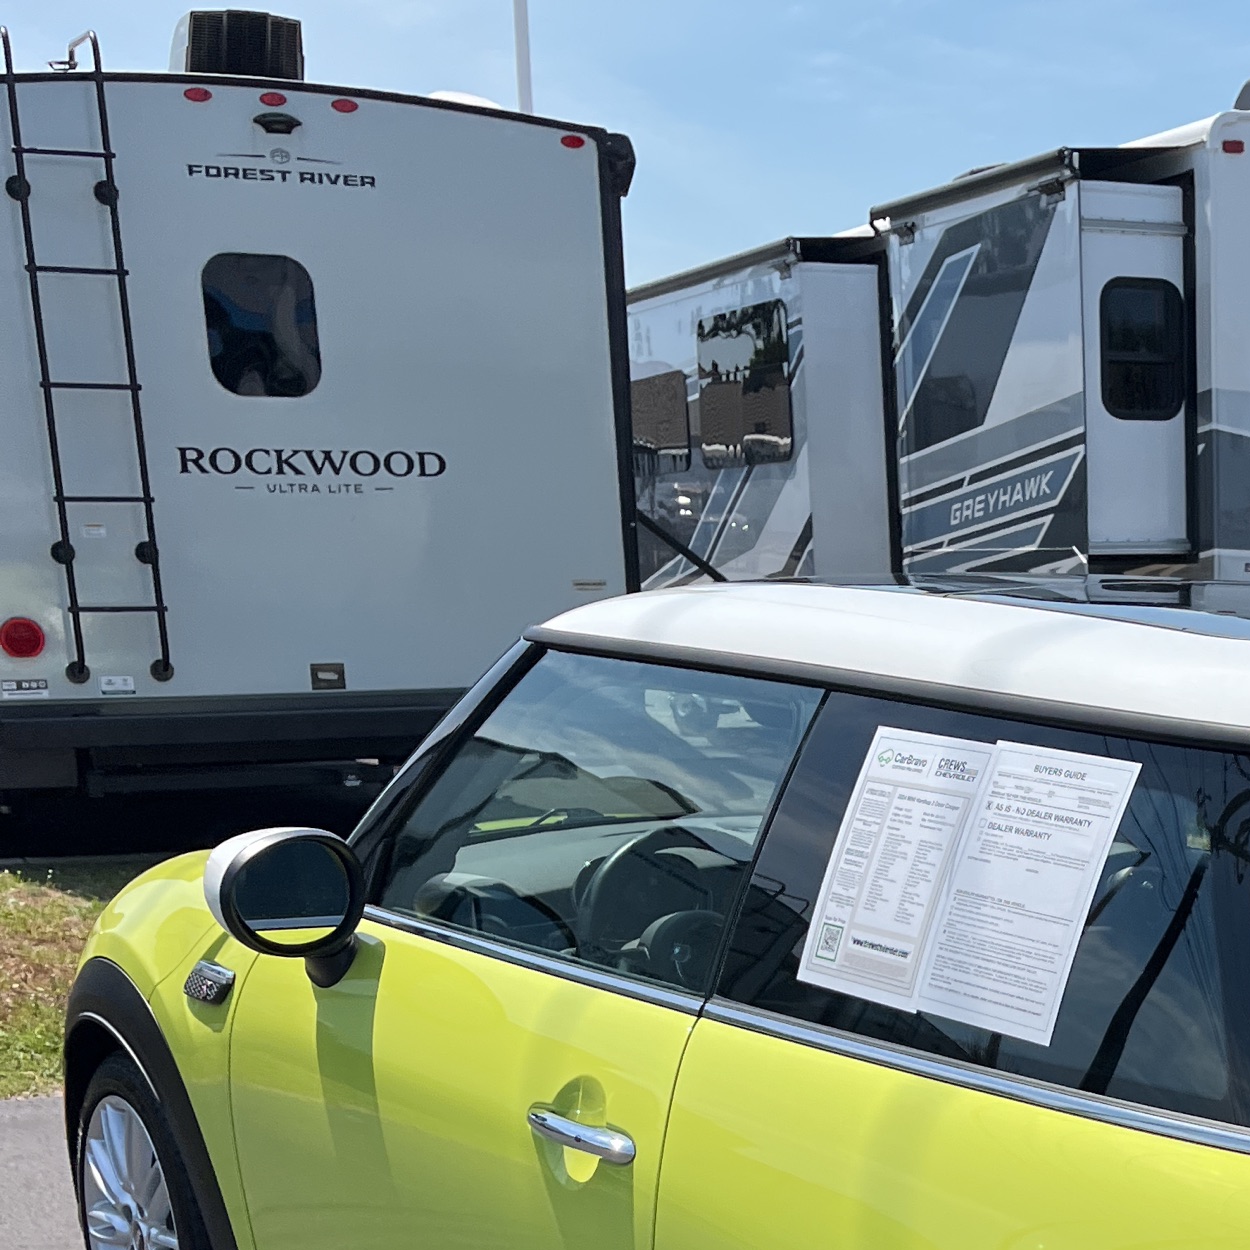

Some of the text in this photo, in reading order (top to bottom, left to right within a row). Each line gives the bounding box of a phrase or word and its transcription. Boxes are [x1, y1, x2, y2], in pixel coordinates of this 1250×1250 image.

[187, 163, 376, 187] FOREST RIVER
[176, 446, 447, 477] ROCKWOOD
[266, 483, 364, 494] ULTRA LITE
[950, 470, 1054, 526] GREYHAWK
[938, 757, 968, 773] CREWS
[1033, 764, 1088, 781] BUYERS GUIDE
[935, 770, 977, 782] CHEVROLET
[995, 802, 1004, 811] AS
[1004, 804, 1011, 813] IS
[1026, 808, 1054, 823] DEALER
[1054, 813, 1093, 828] WARRANTY
[987, 821, 1013, 833] DEALER
[1014, 825, 1053, 841] WARRANTY
